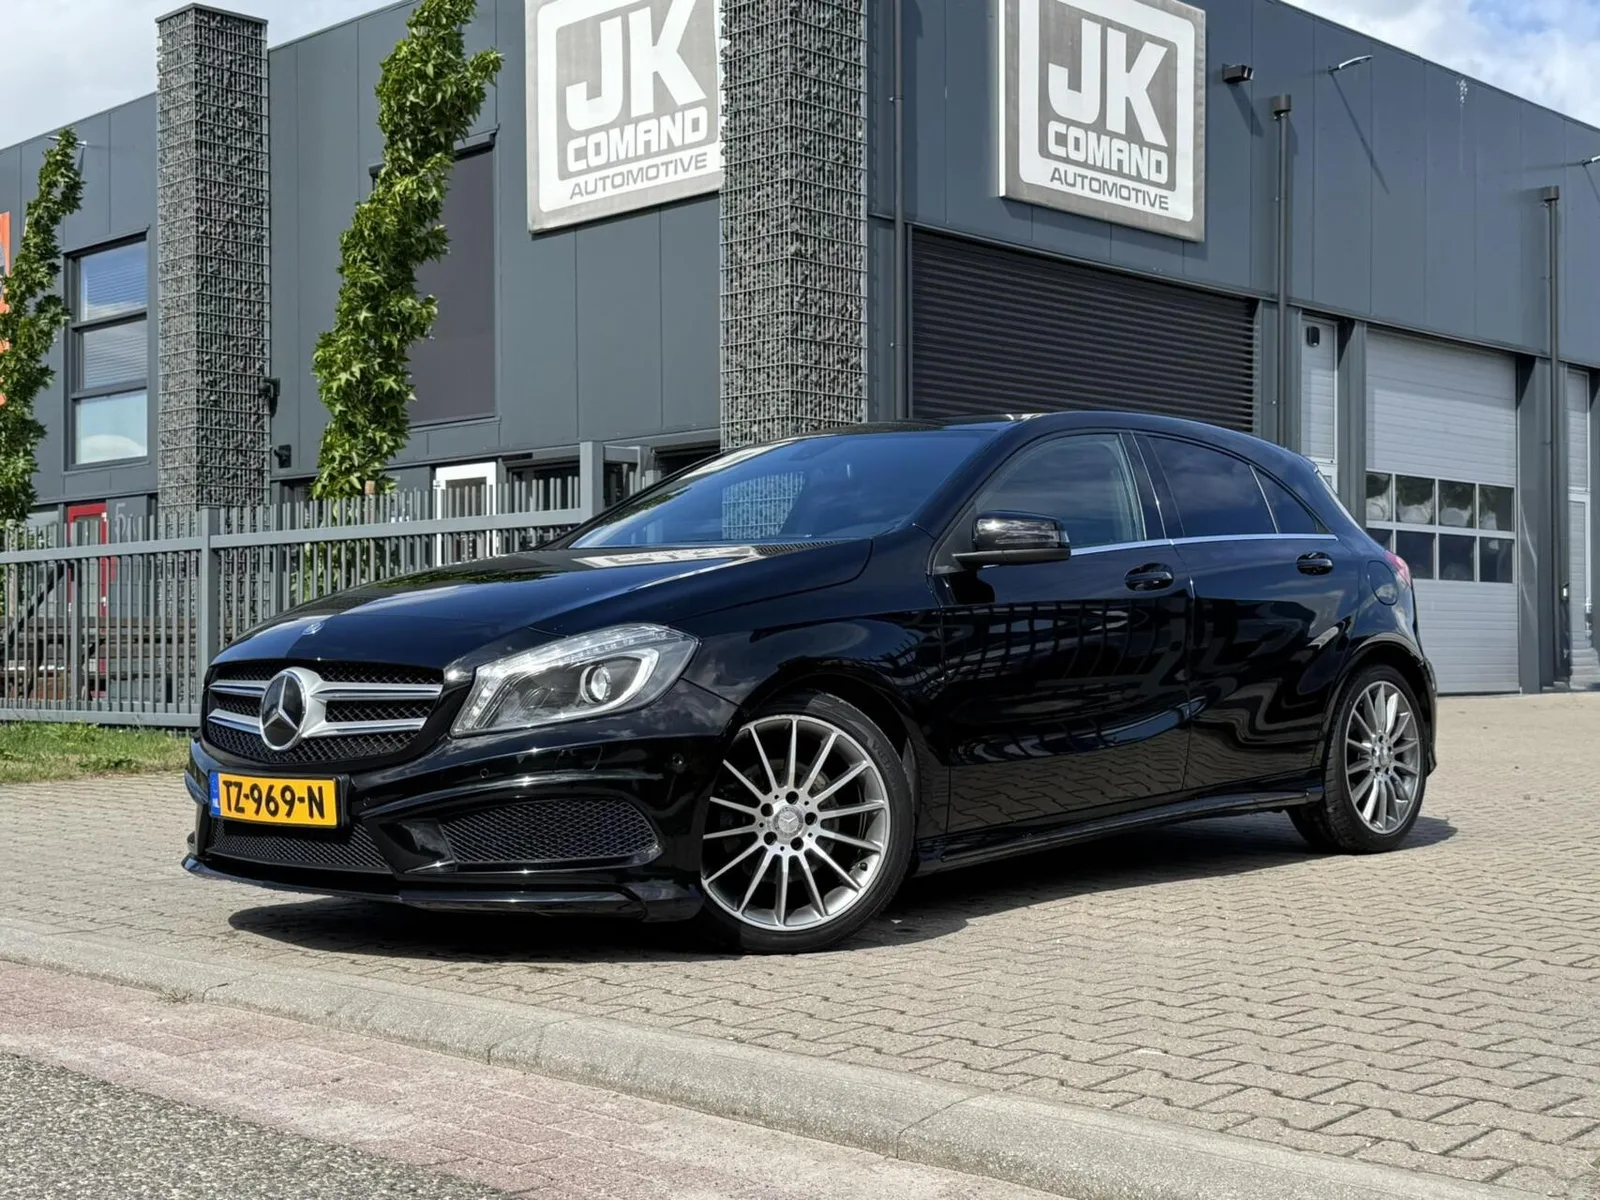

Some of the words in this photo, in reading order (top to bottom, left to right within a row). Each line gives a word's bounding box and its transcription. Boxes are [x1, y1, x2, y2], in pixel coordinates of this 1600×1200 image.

[565, 0, 708, 131] JK
[1048, 18, 1169, 147] JK
[566, 105, 708, 173] COMAND
[1048, 119, 1169, 185] COMAND
[569, 151, 708, 200] AUTOMOTIVE
[1050, 167, 1169, 211] AUTOMOTIVE
[222, 780, 325, 819] TZ-969-N
